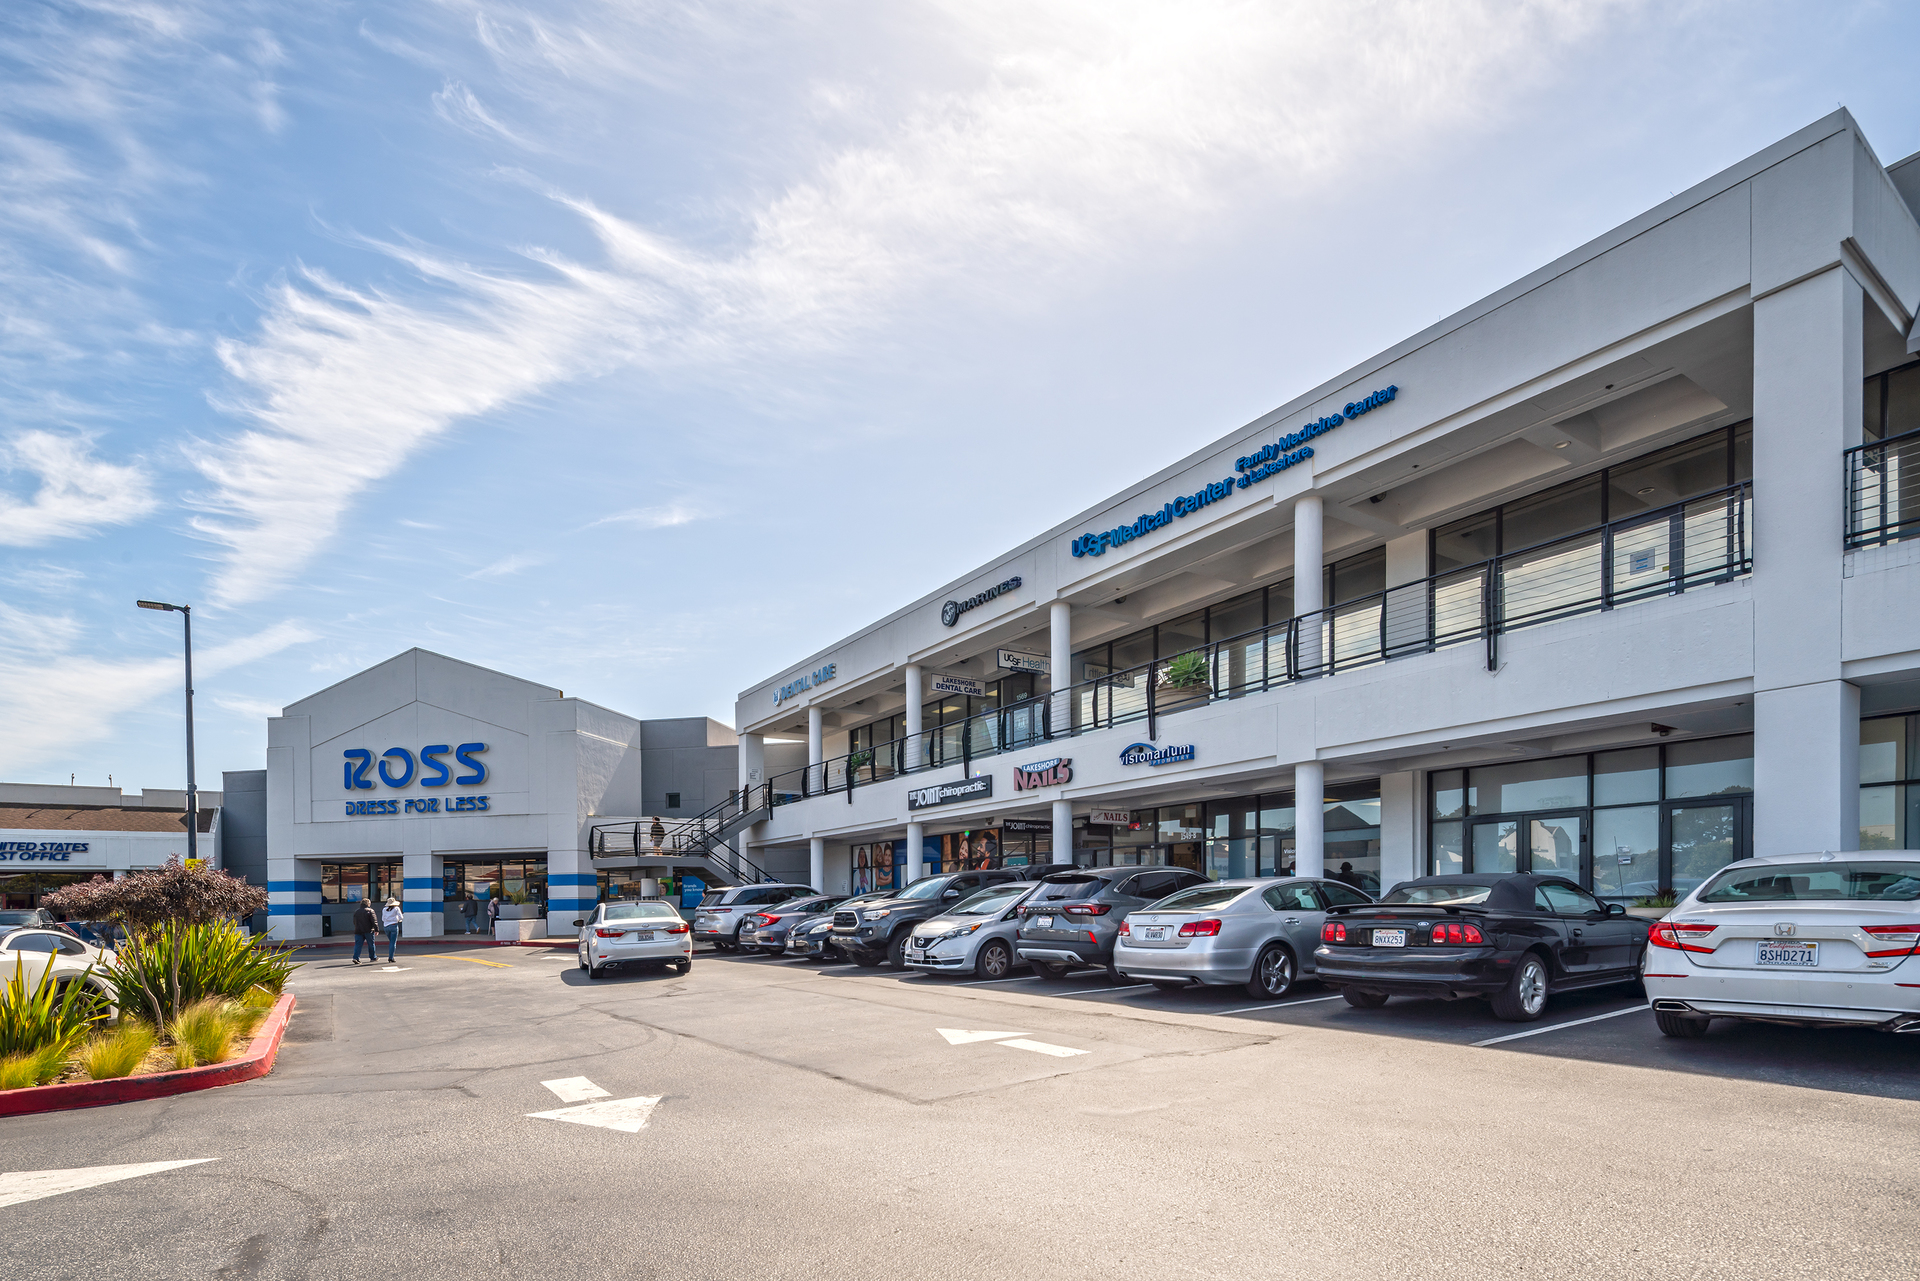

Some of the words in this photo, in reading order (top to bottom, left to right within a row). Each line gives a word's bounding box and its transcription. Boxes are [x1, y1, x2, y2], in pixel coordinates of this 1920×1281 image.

[1235, 443, 1280, 474] Family
[1278, 412, 1345, 452] Medicine
[1343, 384, 1399, 420] Center
[1236, 473, 1252, 490] at
[1249, 445, 1315, 484] Lakeshore
[1071, 532, 1111, 558] UCSF
[1110, 501, 1173, 548] Medical
[1171, 476, 1236, 518] Center
[956, 575, 1022, 615] MARINES
[1003, 653, 1022, 667] UCSF
[1022, 656, 1051, 671] Health
[781, 675, 811, 701] DENTAL
[812, 663, 836, 686] CARE
[935, 682, 963, 693] DENTAL
[963, 686, 982, 696] CARE
[942, 677, 977, 688] LAKESHORE
[1119, 744, 1192, 766] visionarium
[1148, 753, 1191, 766] OPTOMETRY
[344, 742, 489, 790] ROSS
[1023, 759, 1059, 772] LAKESHORE
[1013, 758, 1074, 791] NAILS
[915, 786, 942, 807] JOINT
[939, 780, 987, 798] chiropractic
[346, 800, 399, 816] DRESS
[405, 798, 440, 813] FOR
[445, 796, 490, 812] LESS
[1103, 812, 1129, 823] NAILS
[1010, 822, 1026, 831] JOINT
[0, 842, 37, 851] NITED
[39, 842, 89, 852] STATES
[19, 852, 71, 861] OFFICE
[1374, 935, 1403, 944] 8NXX253
[1769, 942, 1807, 950] California
[1760, 949, 1814, 962] 8SHD271
